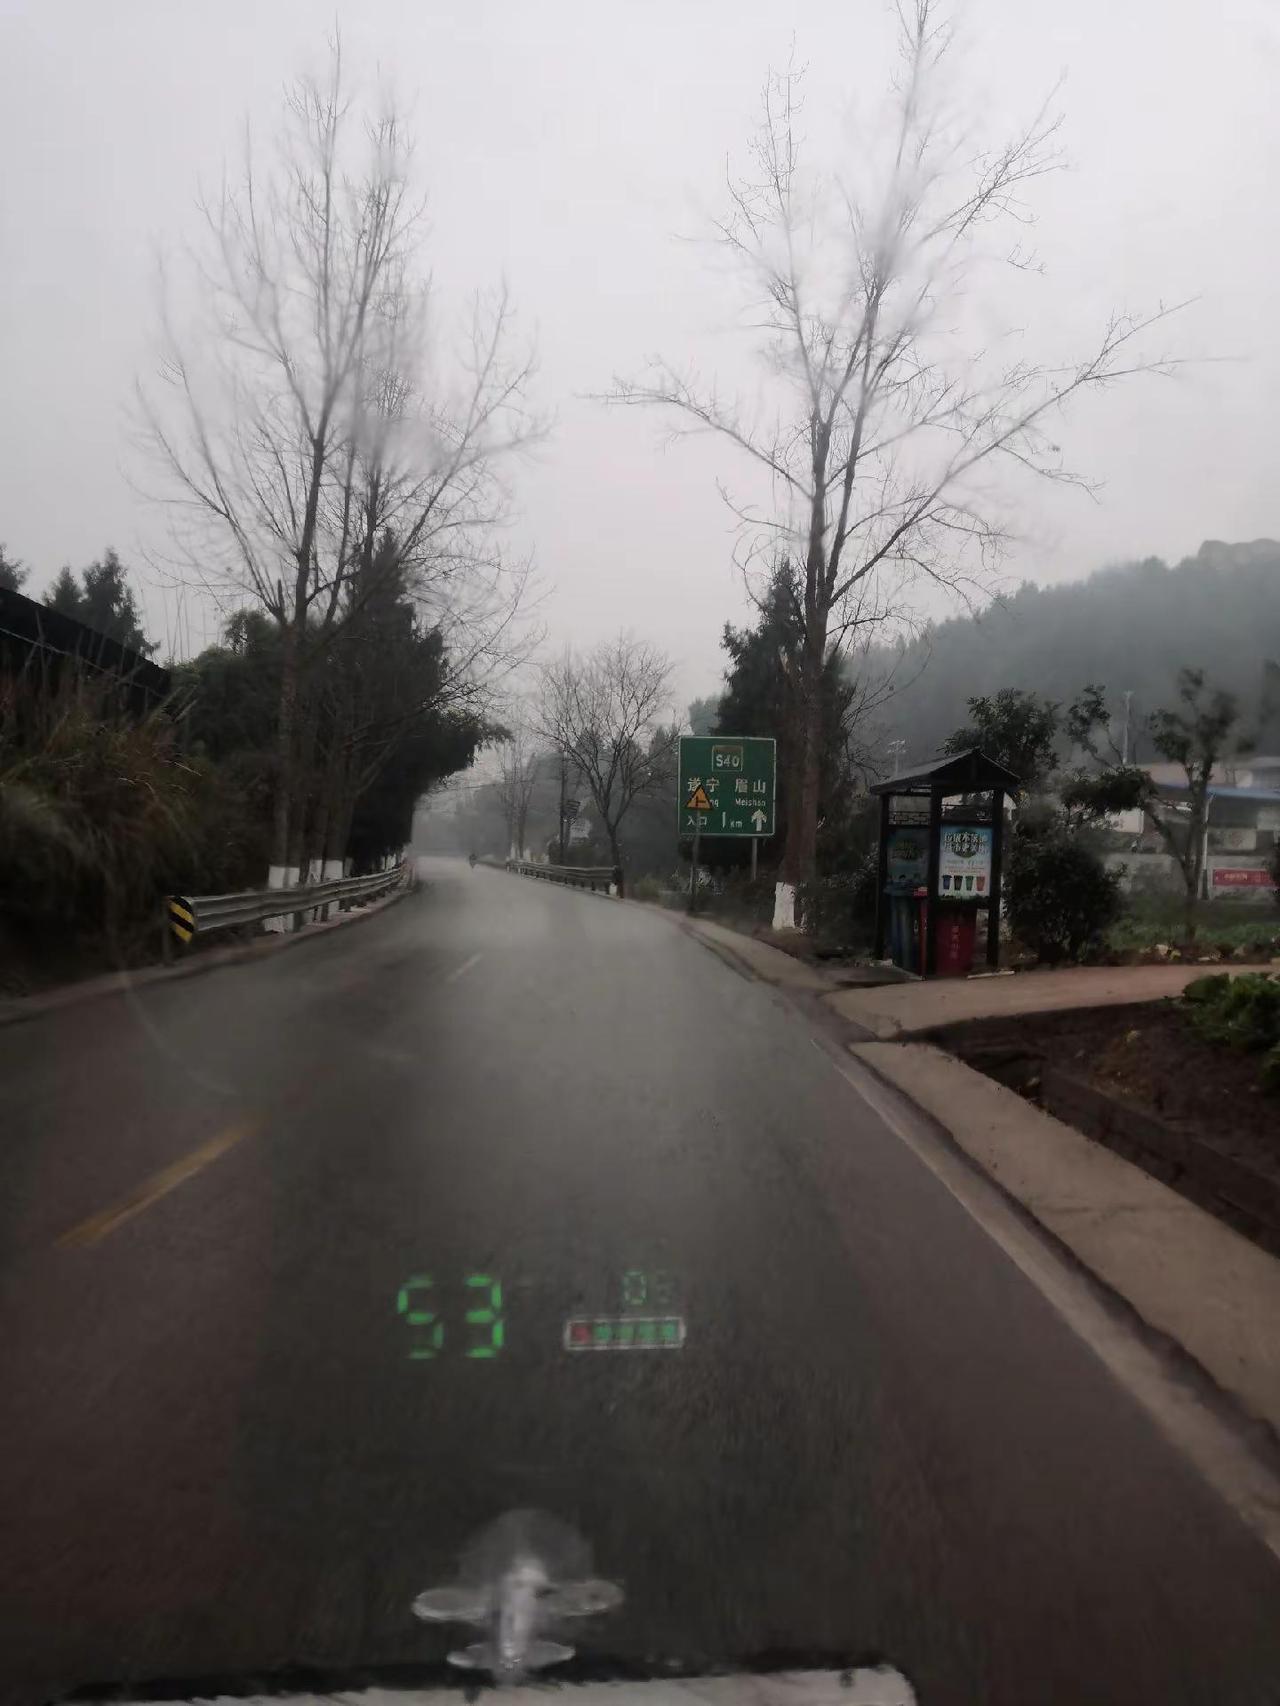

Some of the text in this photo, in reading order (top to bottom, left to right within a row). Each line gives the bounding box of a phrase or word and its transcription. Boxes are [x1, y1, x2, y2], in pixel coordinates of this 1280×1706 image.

[716, 754, 740, 767] S40
[735, 778, 766, 793] 眉山
[735, 798, 766, 807] Meishan
[687, 815, 708, 826] 入口
[730, 819, 743, 828] km
[397, 1274, 505, 1359] 53
